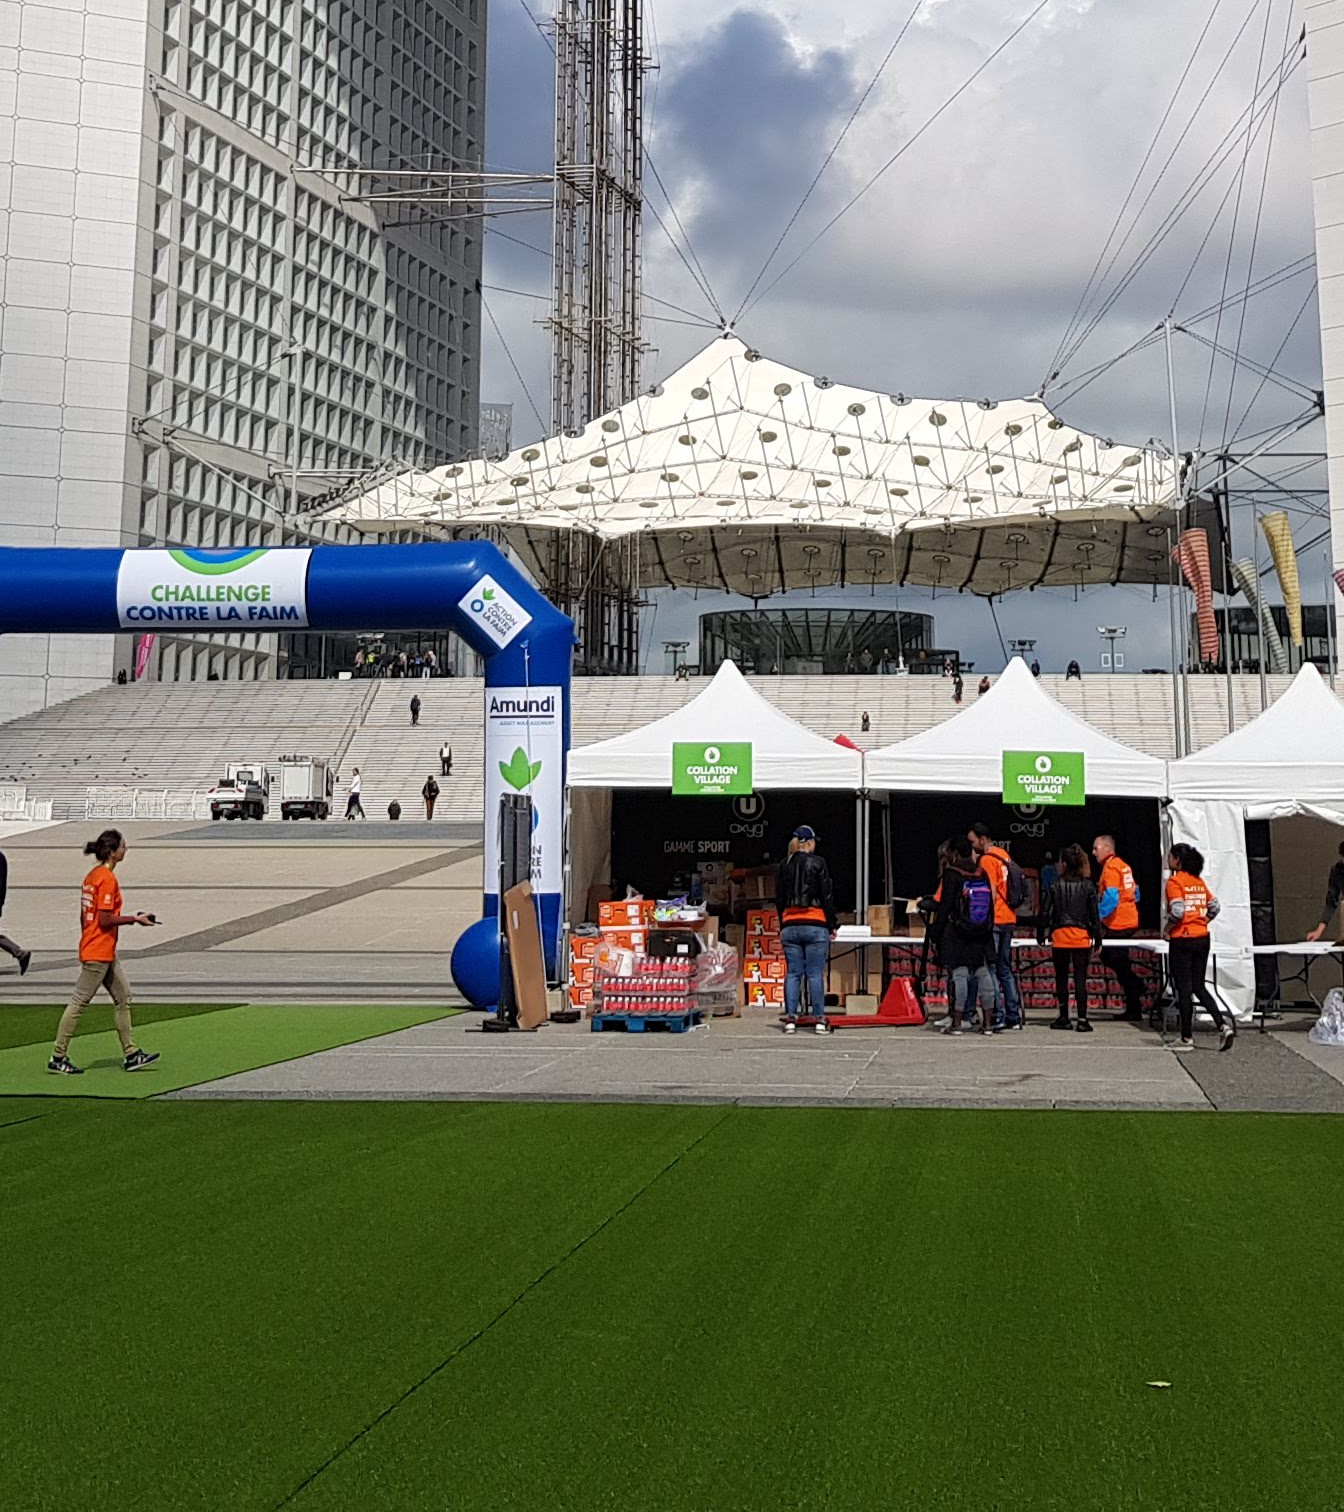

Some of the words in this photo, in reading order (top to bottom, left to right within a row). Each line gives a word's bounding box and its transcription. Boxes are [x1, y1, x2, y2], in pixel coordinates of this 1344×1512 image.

[151, 584, 271, 603] CHALLENGE
[126, 605, 210, 621] CONTRE
[216, 605, 242, 621] LA
[248, 605, 299, 621] FAIM
[487, 606, 512, 631] CONTRE
[492, 602, 518, 626] ACTION
[490, 619, 507, 637] FAIM
[489, 695, 555, 713] Amundi
[686, 766, 738, 775] COLLATION
[694, 775, 731, 784] VILLAGE
[1017, 775, 1070, 785] COLLATION
[1024, 785, 1063, 794] VILLAGE
[740, 798, 757, 814] U
[663, 841, 696, 853] GAMME
[697, 841, 731, 853] SPORT
